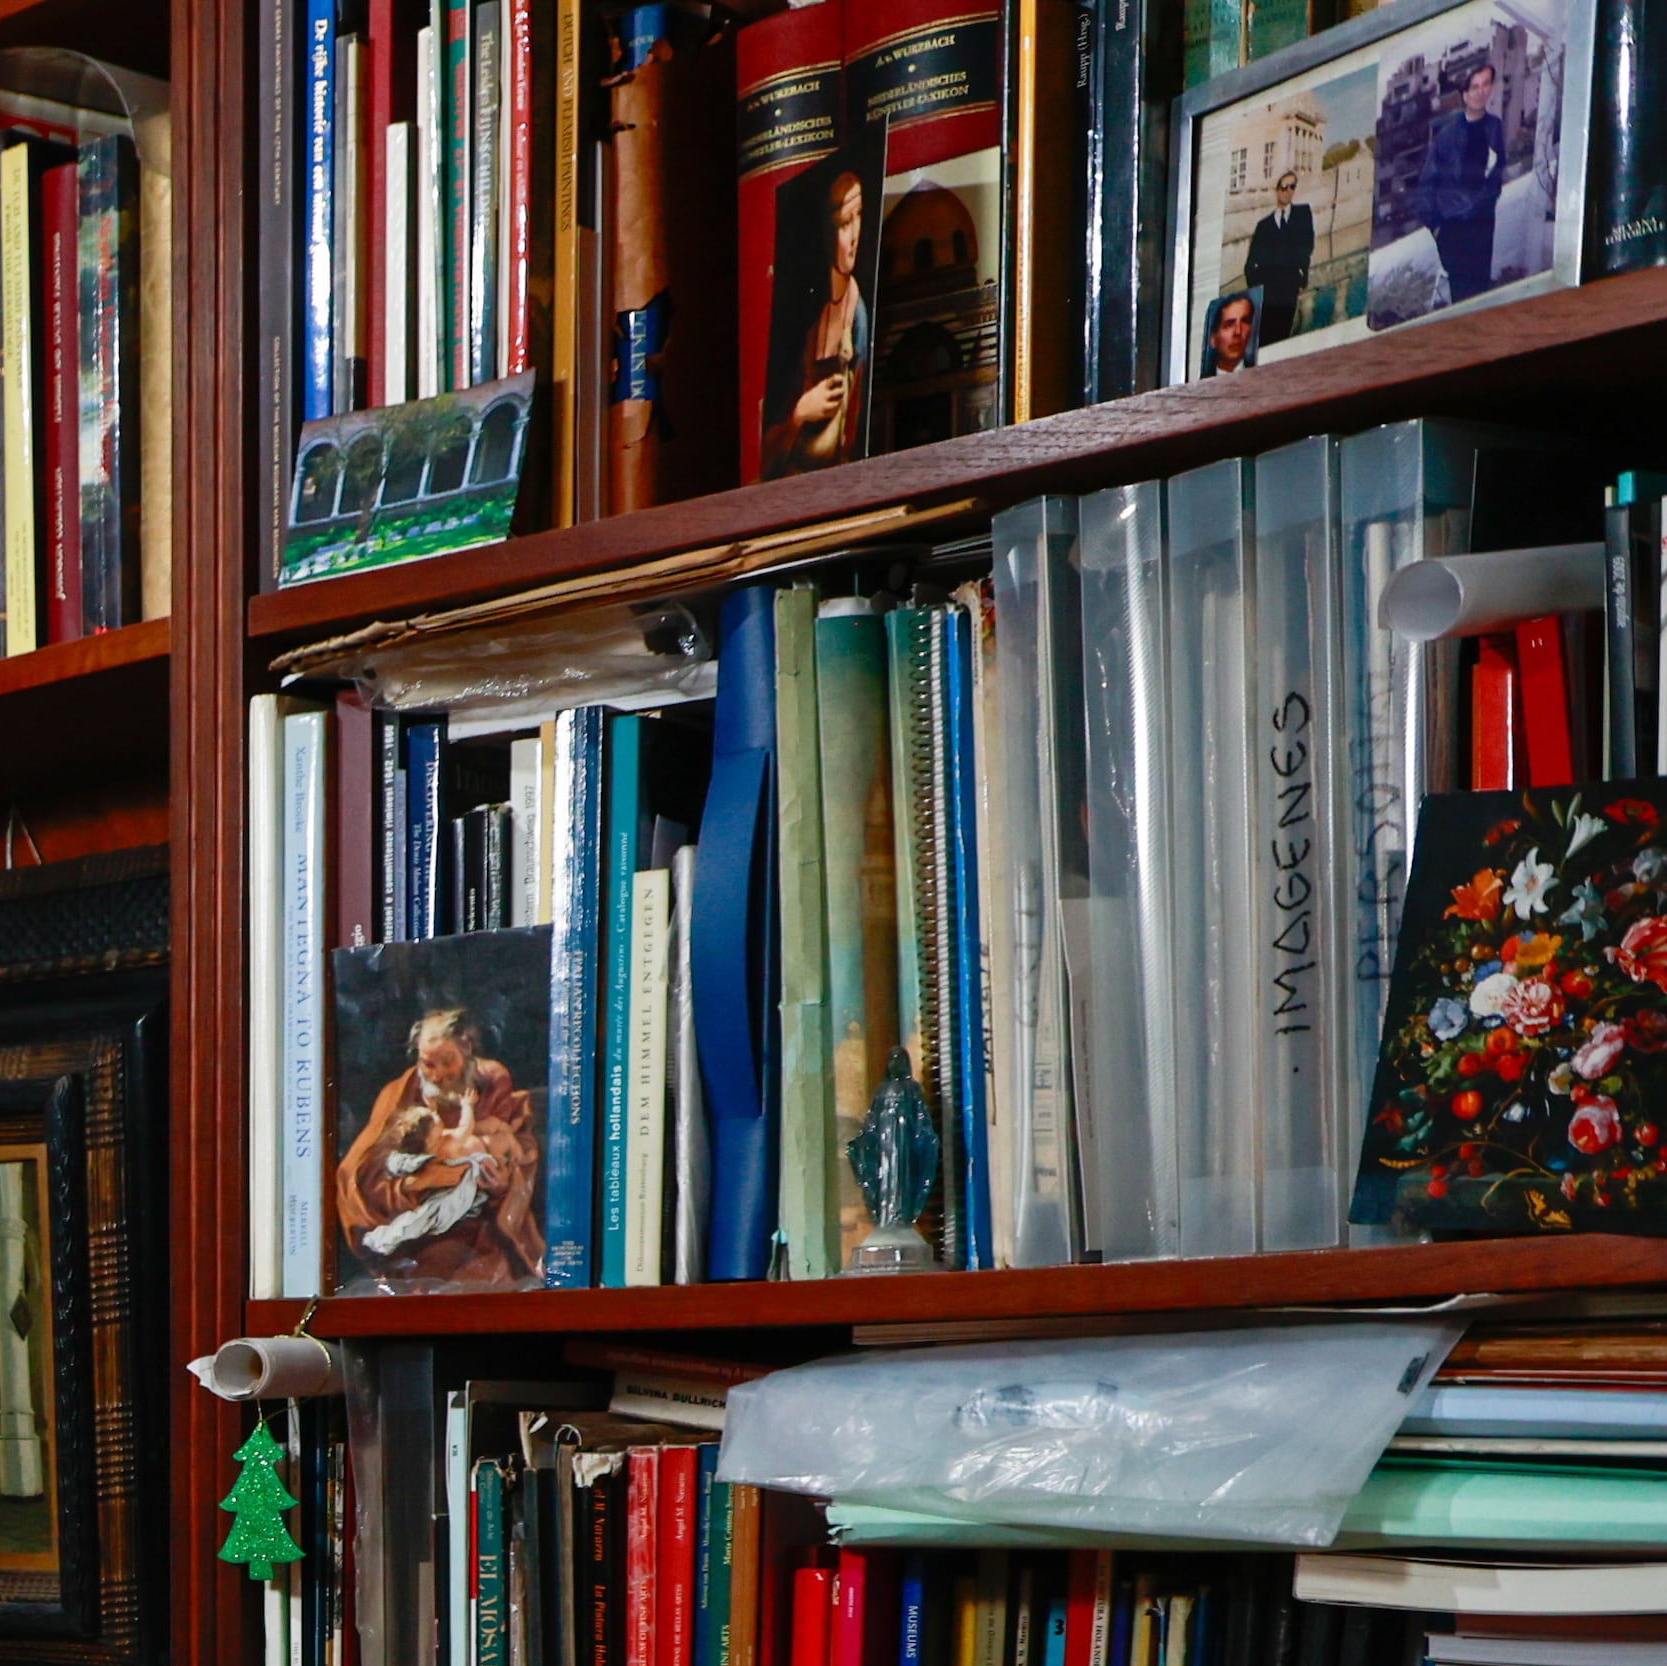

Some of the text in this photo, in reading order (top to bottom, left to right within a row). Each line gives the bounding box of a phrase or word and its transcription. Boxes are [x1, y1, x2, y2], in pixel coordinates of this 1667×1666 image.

[313, 19, 327, 41] De
[561, 13, 573, 63] DUTCH
[311, 45, 327, 76] rijke
[1076, 51, 1091, 88] Raupp
[312, 80, 327, 133] historie
[560, 99, 573, 158] FLEMISH
[560, 161, 573, 233] PAINTINGS
[524, 786, 534, 809] 1997
[1274, 693, 1316, 1035] IMAGENES
[617, 880, 630, 933] Catalogue
[293, 746, 313, 1160] Xanthe Brooke MANTEGNA TO RUBENS
[616, 943, 628, 991] Augustins
[616, 994, 625, 1009] des
[638, 888, 657, 1137] DEM HIMMEL ENTGEGEN
[614, 1047, 623, 1060] du
[608, 1064, 622, 1141] hollandais
[608, 1206, 620, 1230] Les
[479, 1554, 499, 1590] EL
[592, 1584, 606, 1598] La
[592, 1601, 606, 1640] Pintura
[719, 1623, 730, 1647] ARTS
[906, 1605, 919, 1658] MUSEUMS
